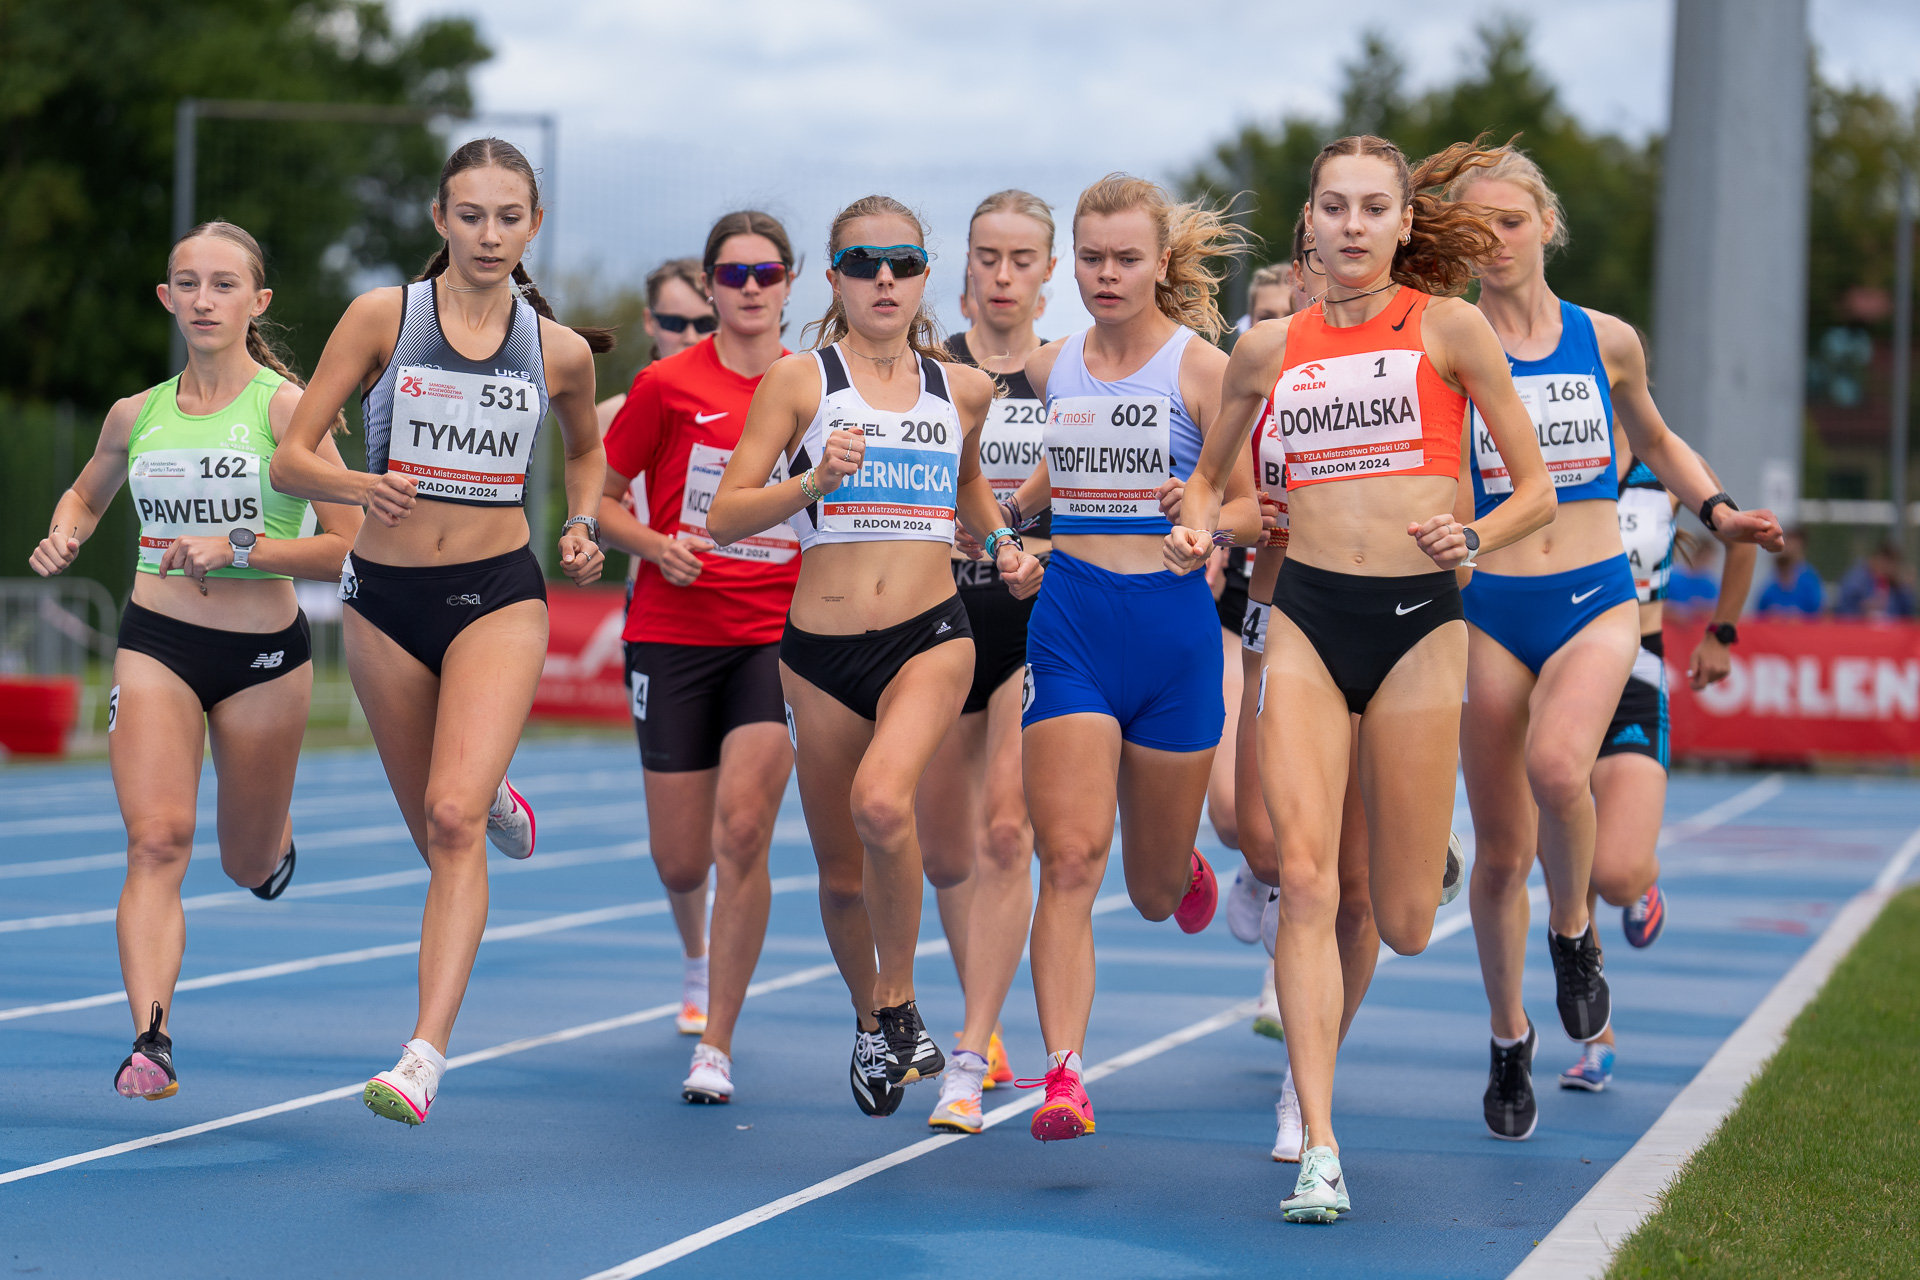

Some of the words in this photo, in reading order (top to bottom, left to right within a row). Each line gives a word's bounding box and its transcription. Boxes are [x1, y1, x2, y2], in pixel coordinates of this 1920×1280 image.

[494, 368, 531, 380] UKS
[1373, 357, 1387, 378] 1
[1292, 381, 1326, 392] ORLEN
[1545, 381, 1590, 403] 168
[479, 384, 529, 412] 531
[1004, 406, 1047, 425] 220
[1063, 410, 1096, 423] mosir
[1111, 404, 1158, 427] 602
[1280, 396, 1416, 437] DOMŻALSKA
[409, 419, 520, 458] TYMAN
[900, 420, 947, 445] 200
[1480, 418, 1605, 454] KLCZUK
[1048, 446, 1164, 474] TEOFILEWSKA
[1303, 452, 1322, 461] PZLA
[1322, 447, 1368, 459] Mistrzostwa
[1369, 443, 1393, 453] Polski
[1393, 442, 1410, 451] U20
[199, 456, 247, 479] 162
[401, 463, 412, 472] 78.
[413, 466, 431, 476] PZLA
[433, 469, 481, 481] Mistrzostwa
[482, 475, 503, 483] Polski
[503, 475, 515, 483] U20
[1311, 461, 1356, 476] RADOM
[1358, 457, 1390, 470] 2024
[1563, 460, 1584, 470] Polski
[1585, 458, 1600, 468] U20
[1554, 473, 1582, 484] 2024
[417, 480, 466, 495] RADOM
[468, 486, 498, 498] 2024
[1077, 491, 1118, 499] Mistrzostwa
[1119, 491, 1141, 499] Polski
[138, 497, 258, 524] PAWELUS
[835, 506, 846, 514] 78.
[867, 506, 912, 515] Mistrzostwa
[913, 508, 935, 517] Polski
[936, 510, 949, 518] U20
[1069, 503, 1106, 513] RADOM
[1108, 504, 1138, 513] 2024
[853, 519, 901, 529] RADOM
[903, 520, 932, 531] 2024
[148, 539, 157, 547] 78.
[1243, 606, 1262, 647] 4
[1698, 653, 1920, 720] ORLEN
